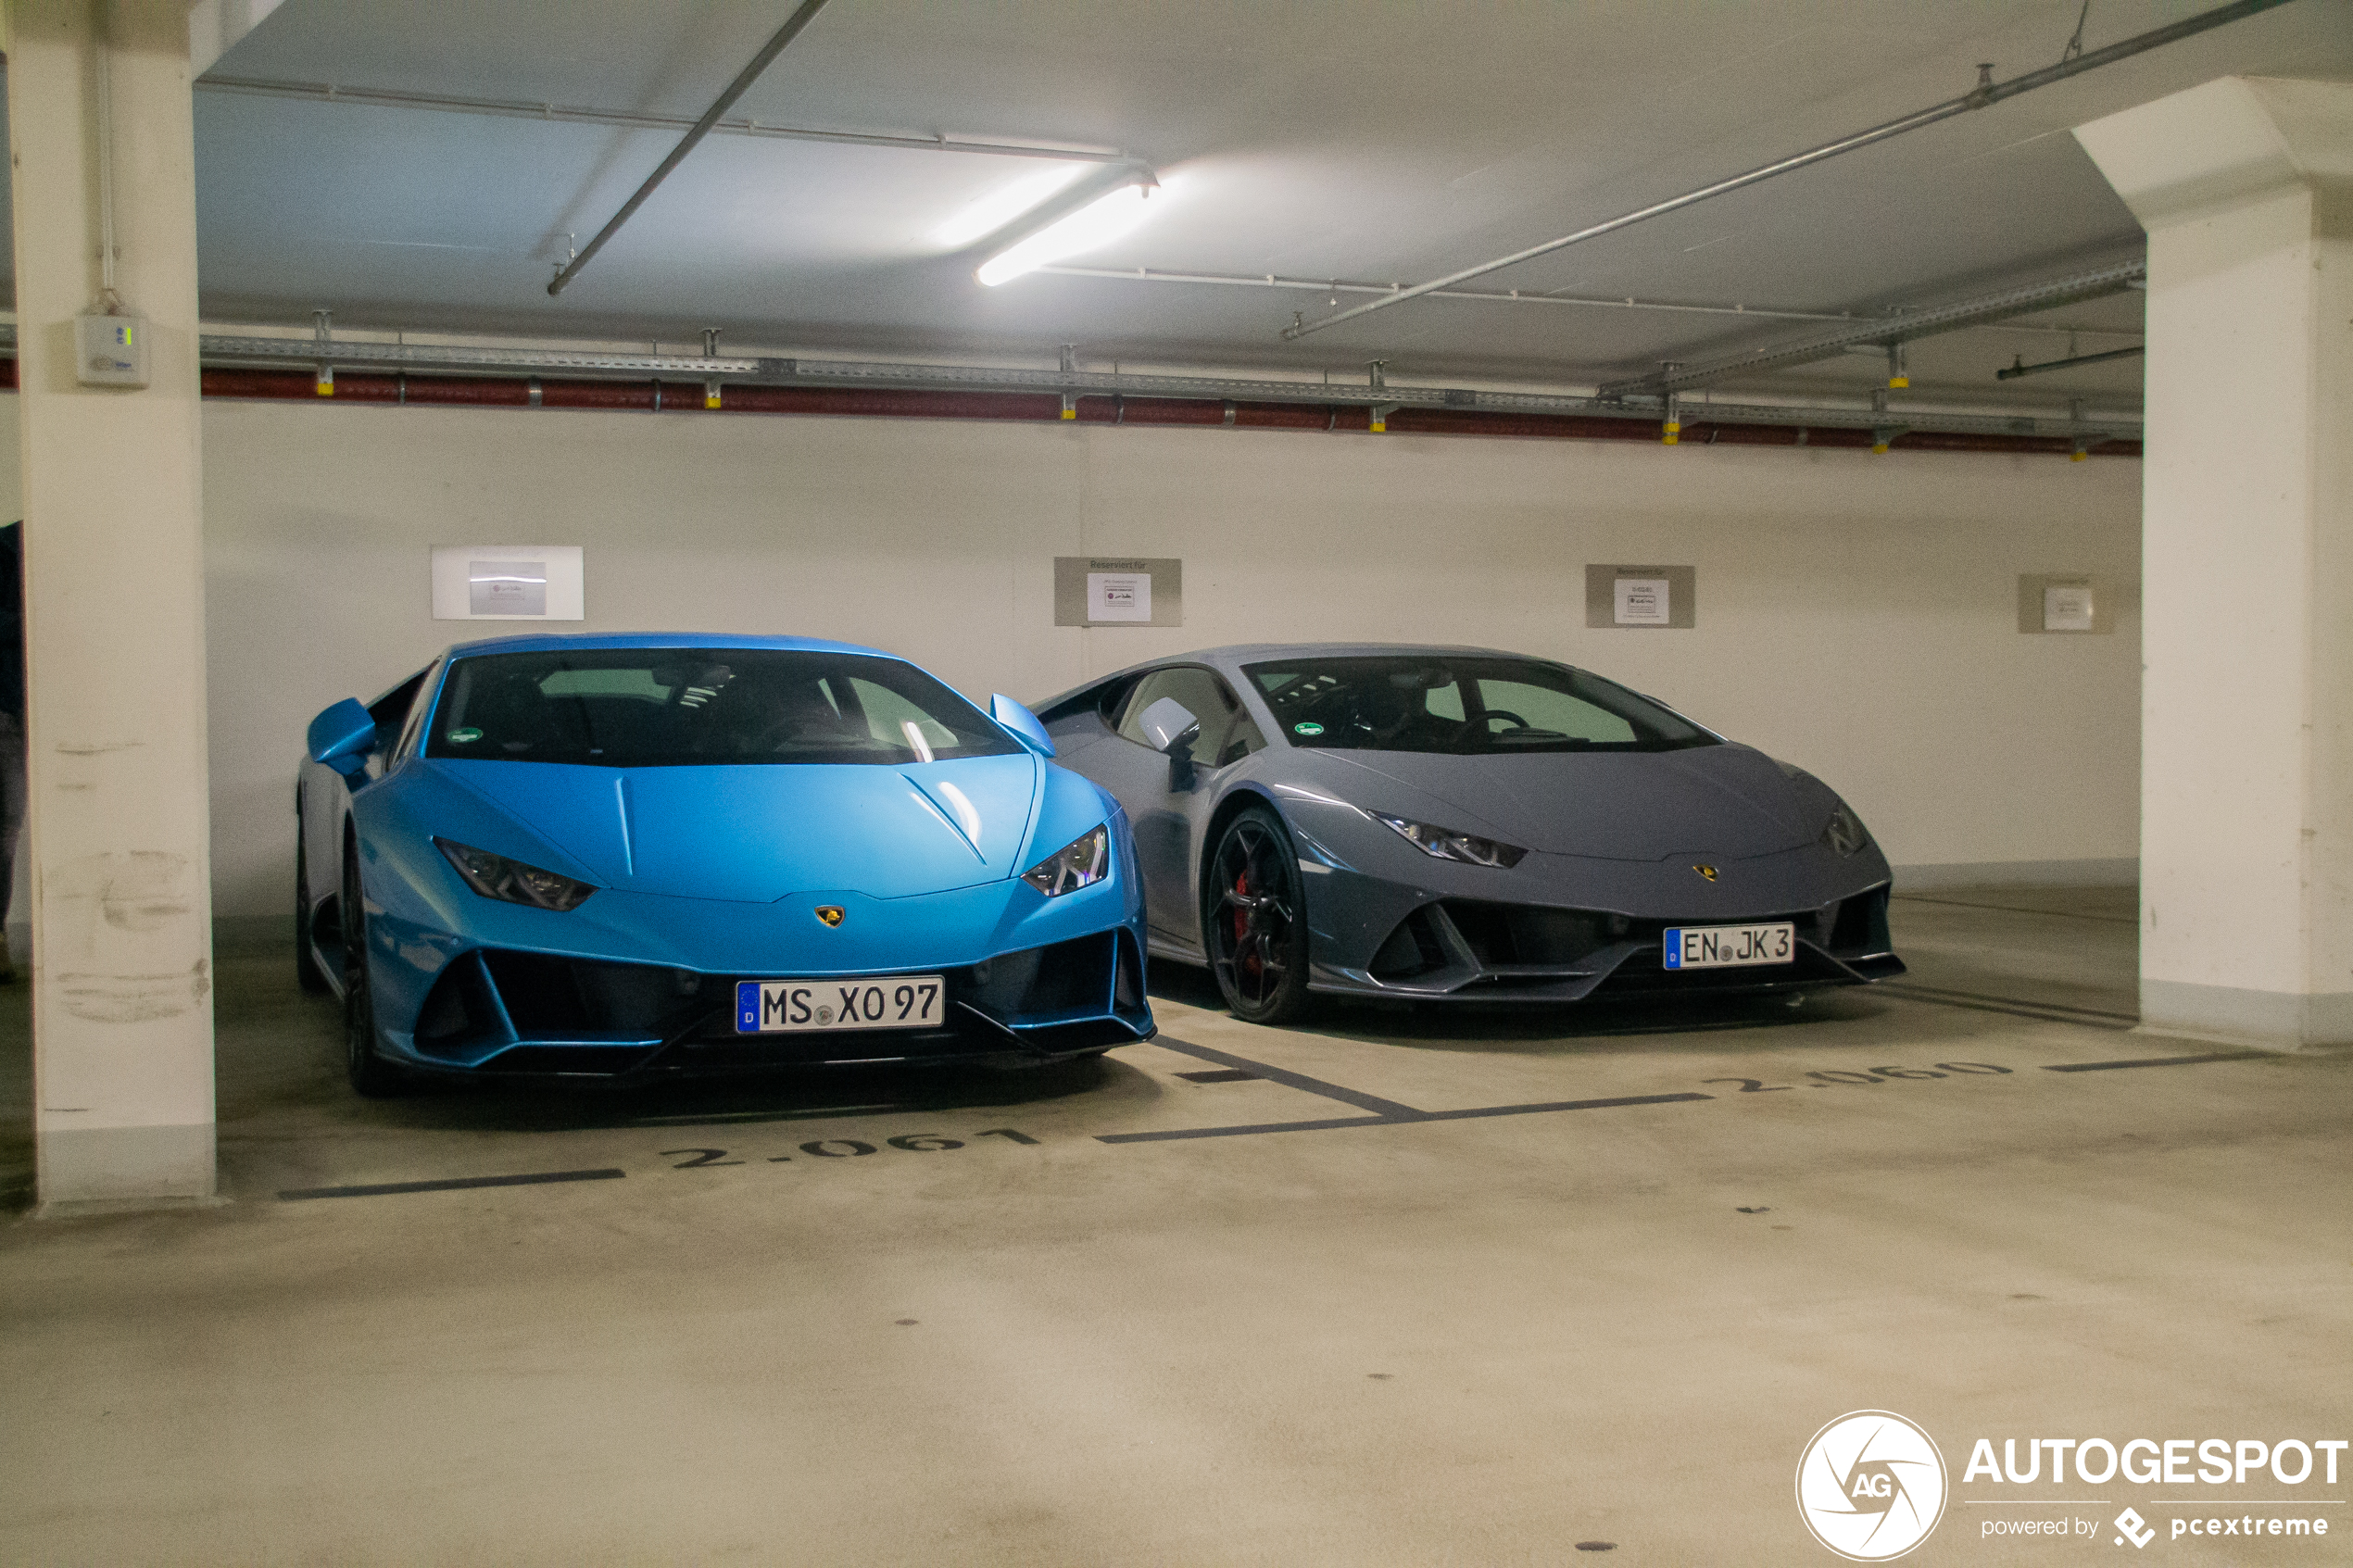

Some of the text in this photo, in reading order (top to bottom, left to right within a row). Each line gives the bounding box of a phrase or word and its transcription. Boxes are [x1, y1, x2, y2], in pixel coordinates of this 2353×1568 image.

[1090, 559, 1148, 569] Reserviert für
[1683, 928, 1789, 961] EN JK 3
[745, 1011, 754, 1022] D
[763, 984, 938, 1024] MS XO 97
[1700, 1061, 2014, 1093] 2.060
[659, 1128, 1041, 1170] 2.061
